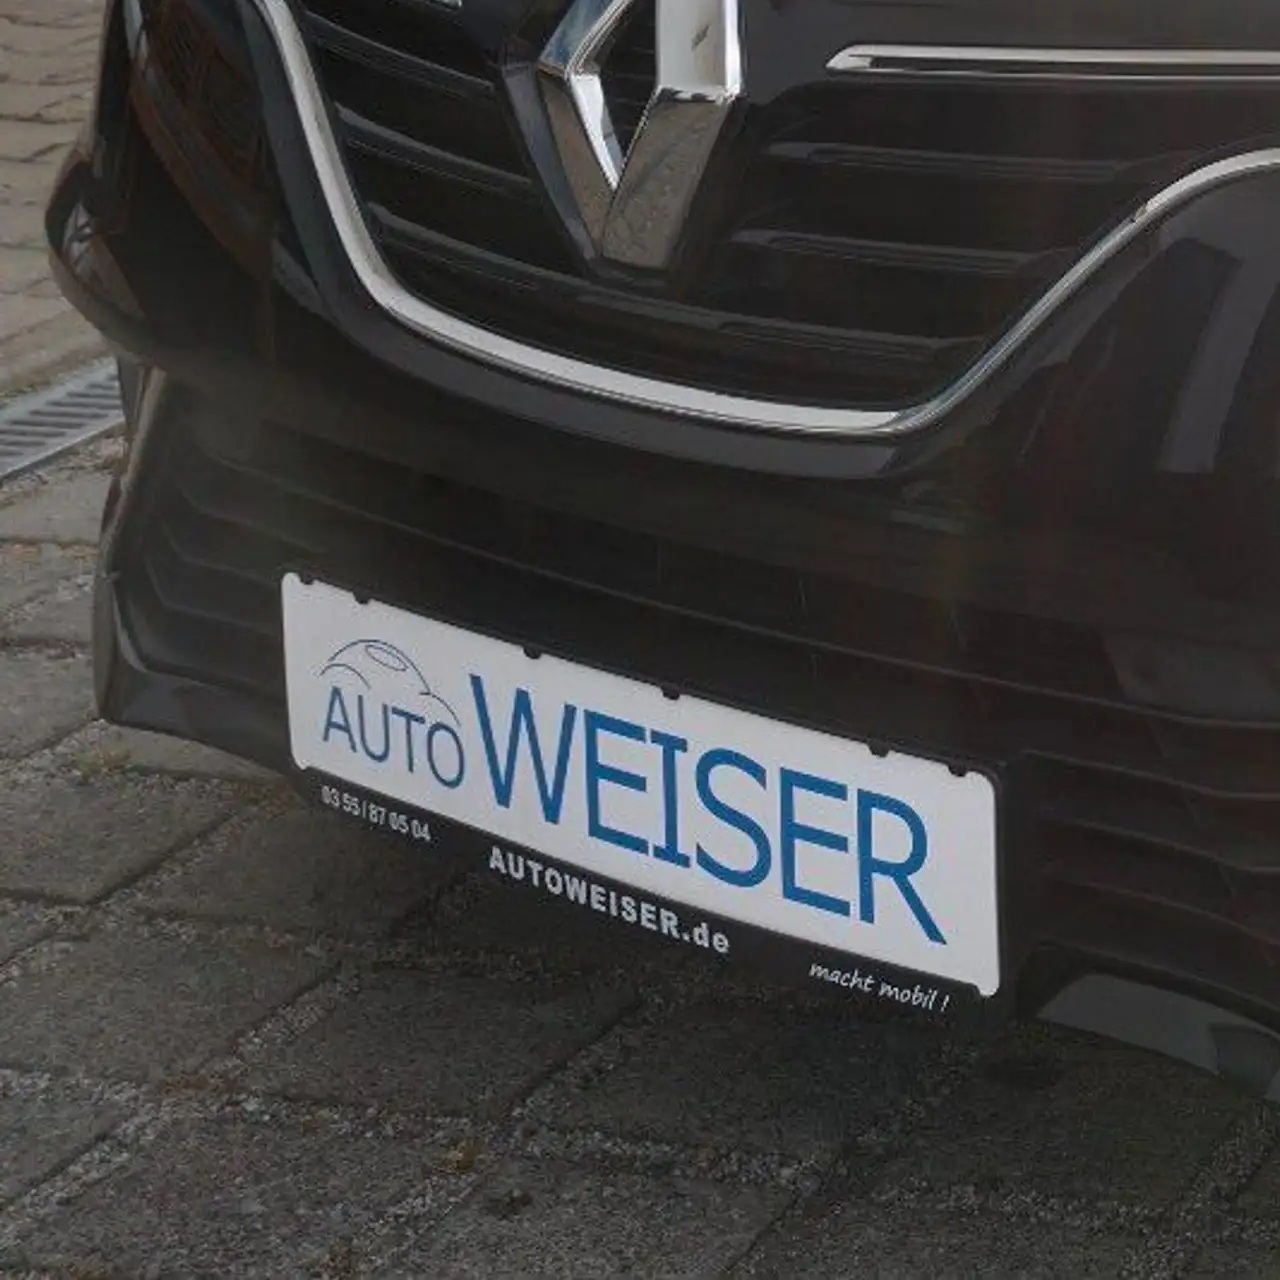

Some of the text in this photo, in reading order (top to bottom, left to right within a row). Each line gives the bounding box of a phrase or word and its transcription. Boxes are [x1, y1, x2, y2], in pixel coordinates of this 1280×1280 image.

[322, 673, 947, 946] AUTO WEISER
[489, 845, 730, 954] AUTOWEISER.de
[808, 963, 875, 993] macht
